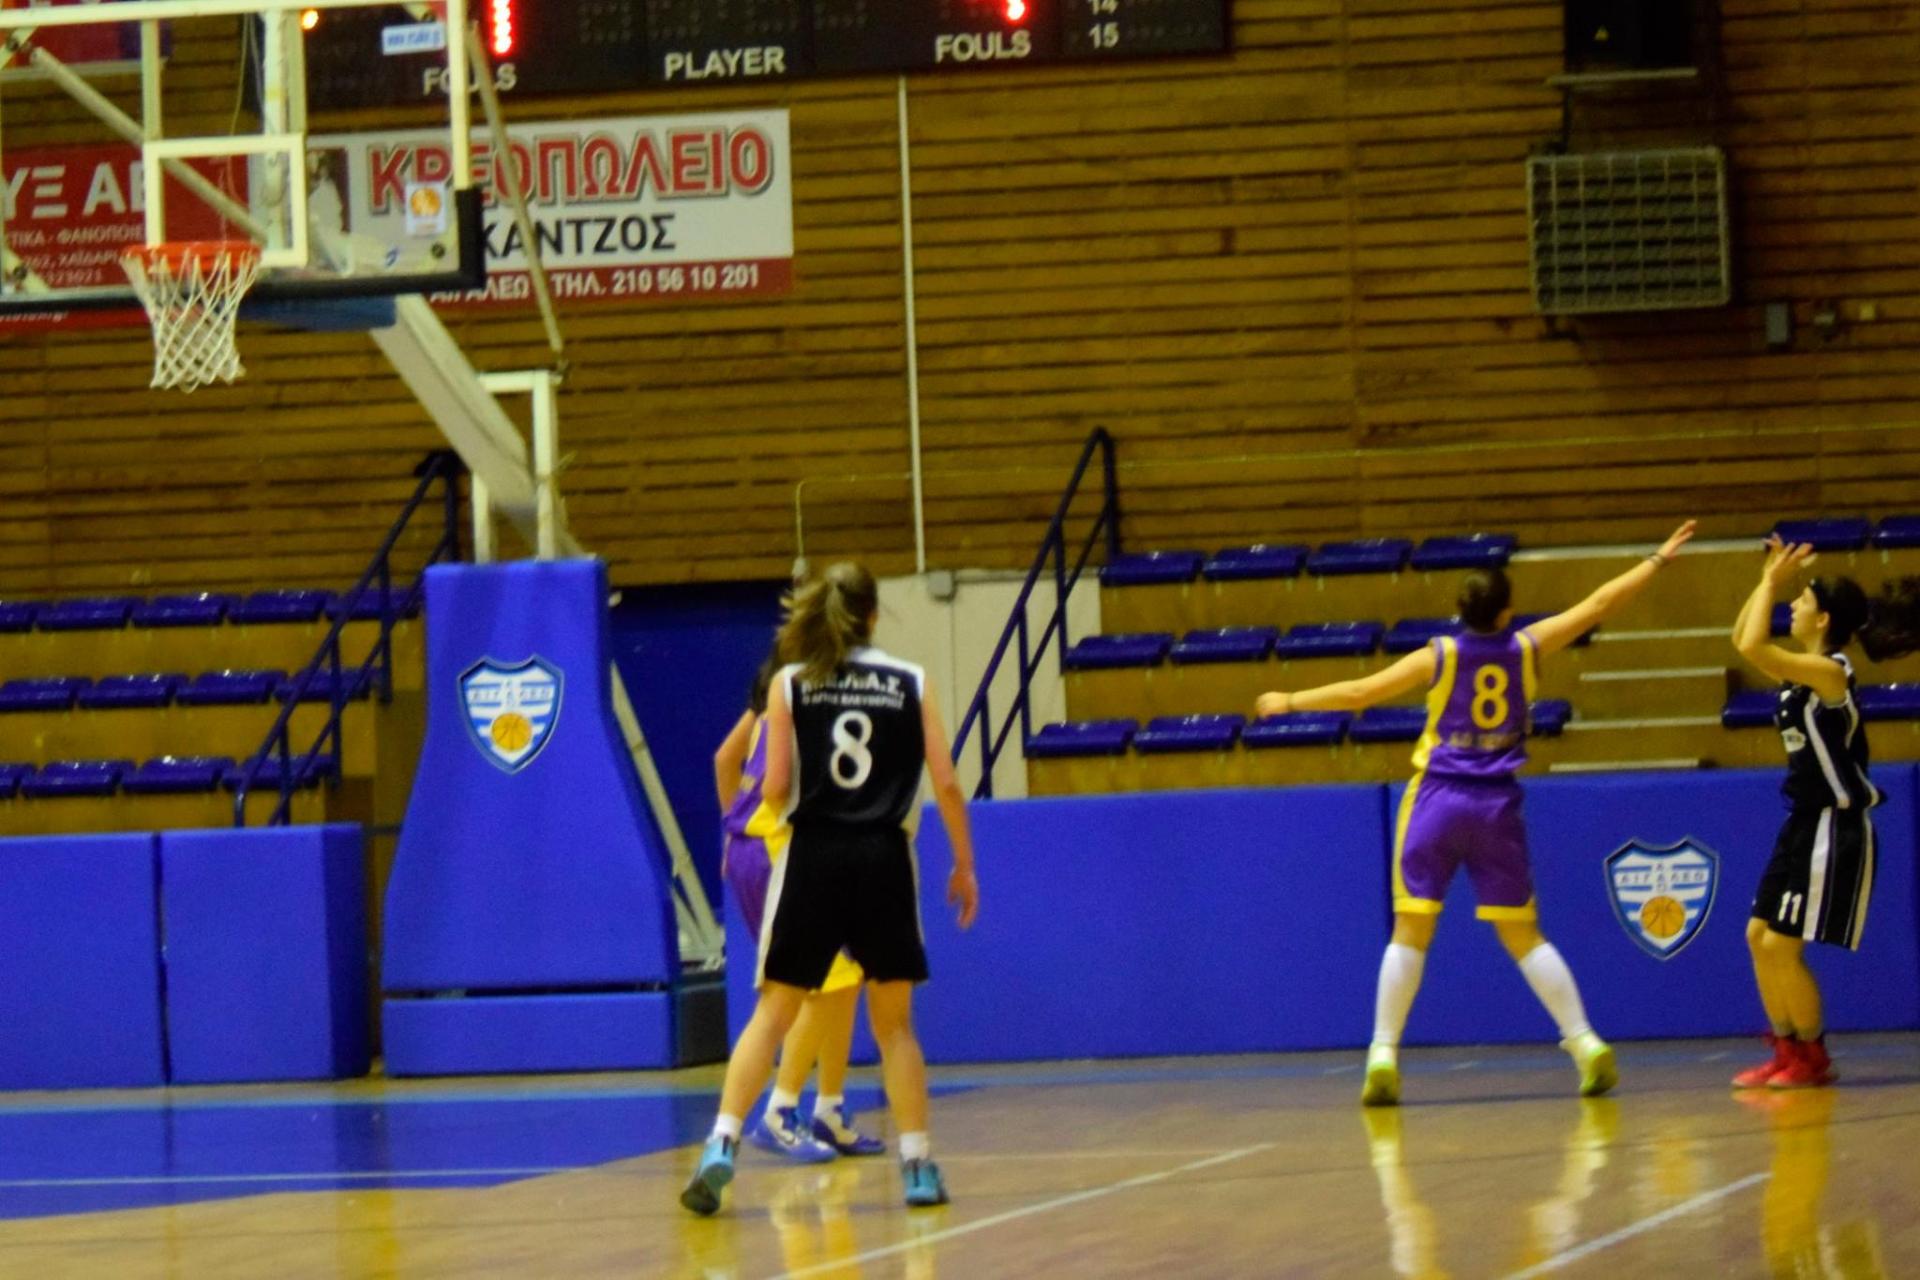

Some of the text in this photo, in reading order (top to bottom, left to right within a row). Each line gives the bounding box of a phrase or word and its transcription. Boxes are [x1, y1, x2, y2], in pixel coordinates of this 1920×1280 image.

[935, 30, 1031, 63] FOULS
[1088, 22, 1119, 48] 15
[664, 46, 786, 81] PLAYER
[612, 268, 652, 294] 210
[657, 267, 685, 292] 56
[690, 265, 717, 289] 10
[721, 263, 759, 289] 201
[1471, 663, 1509, 730] 8
[830, 710, 873, 789] 8
[1778, 890, 1803, 924] 11
